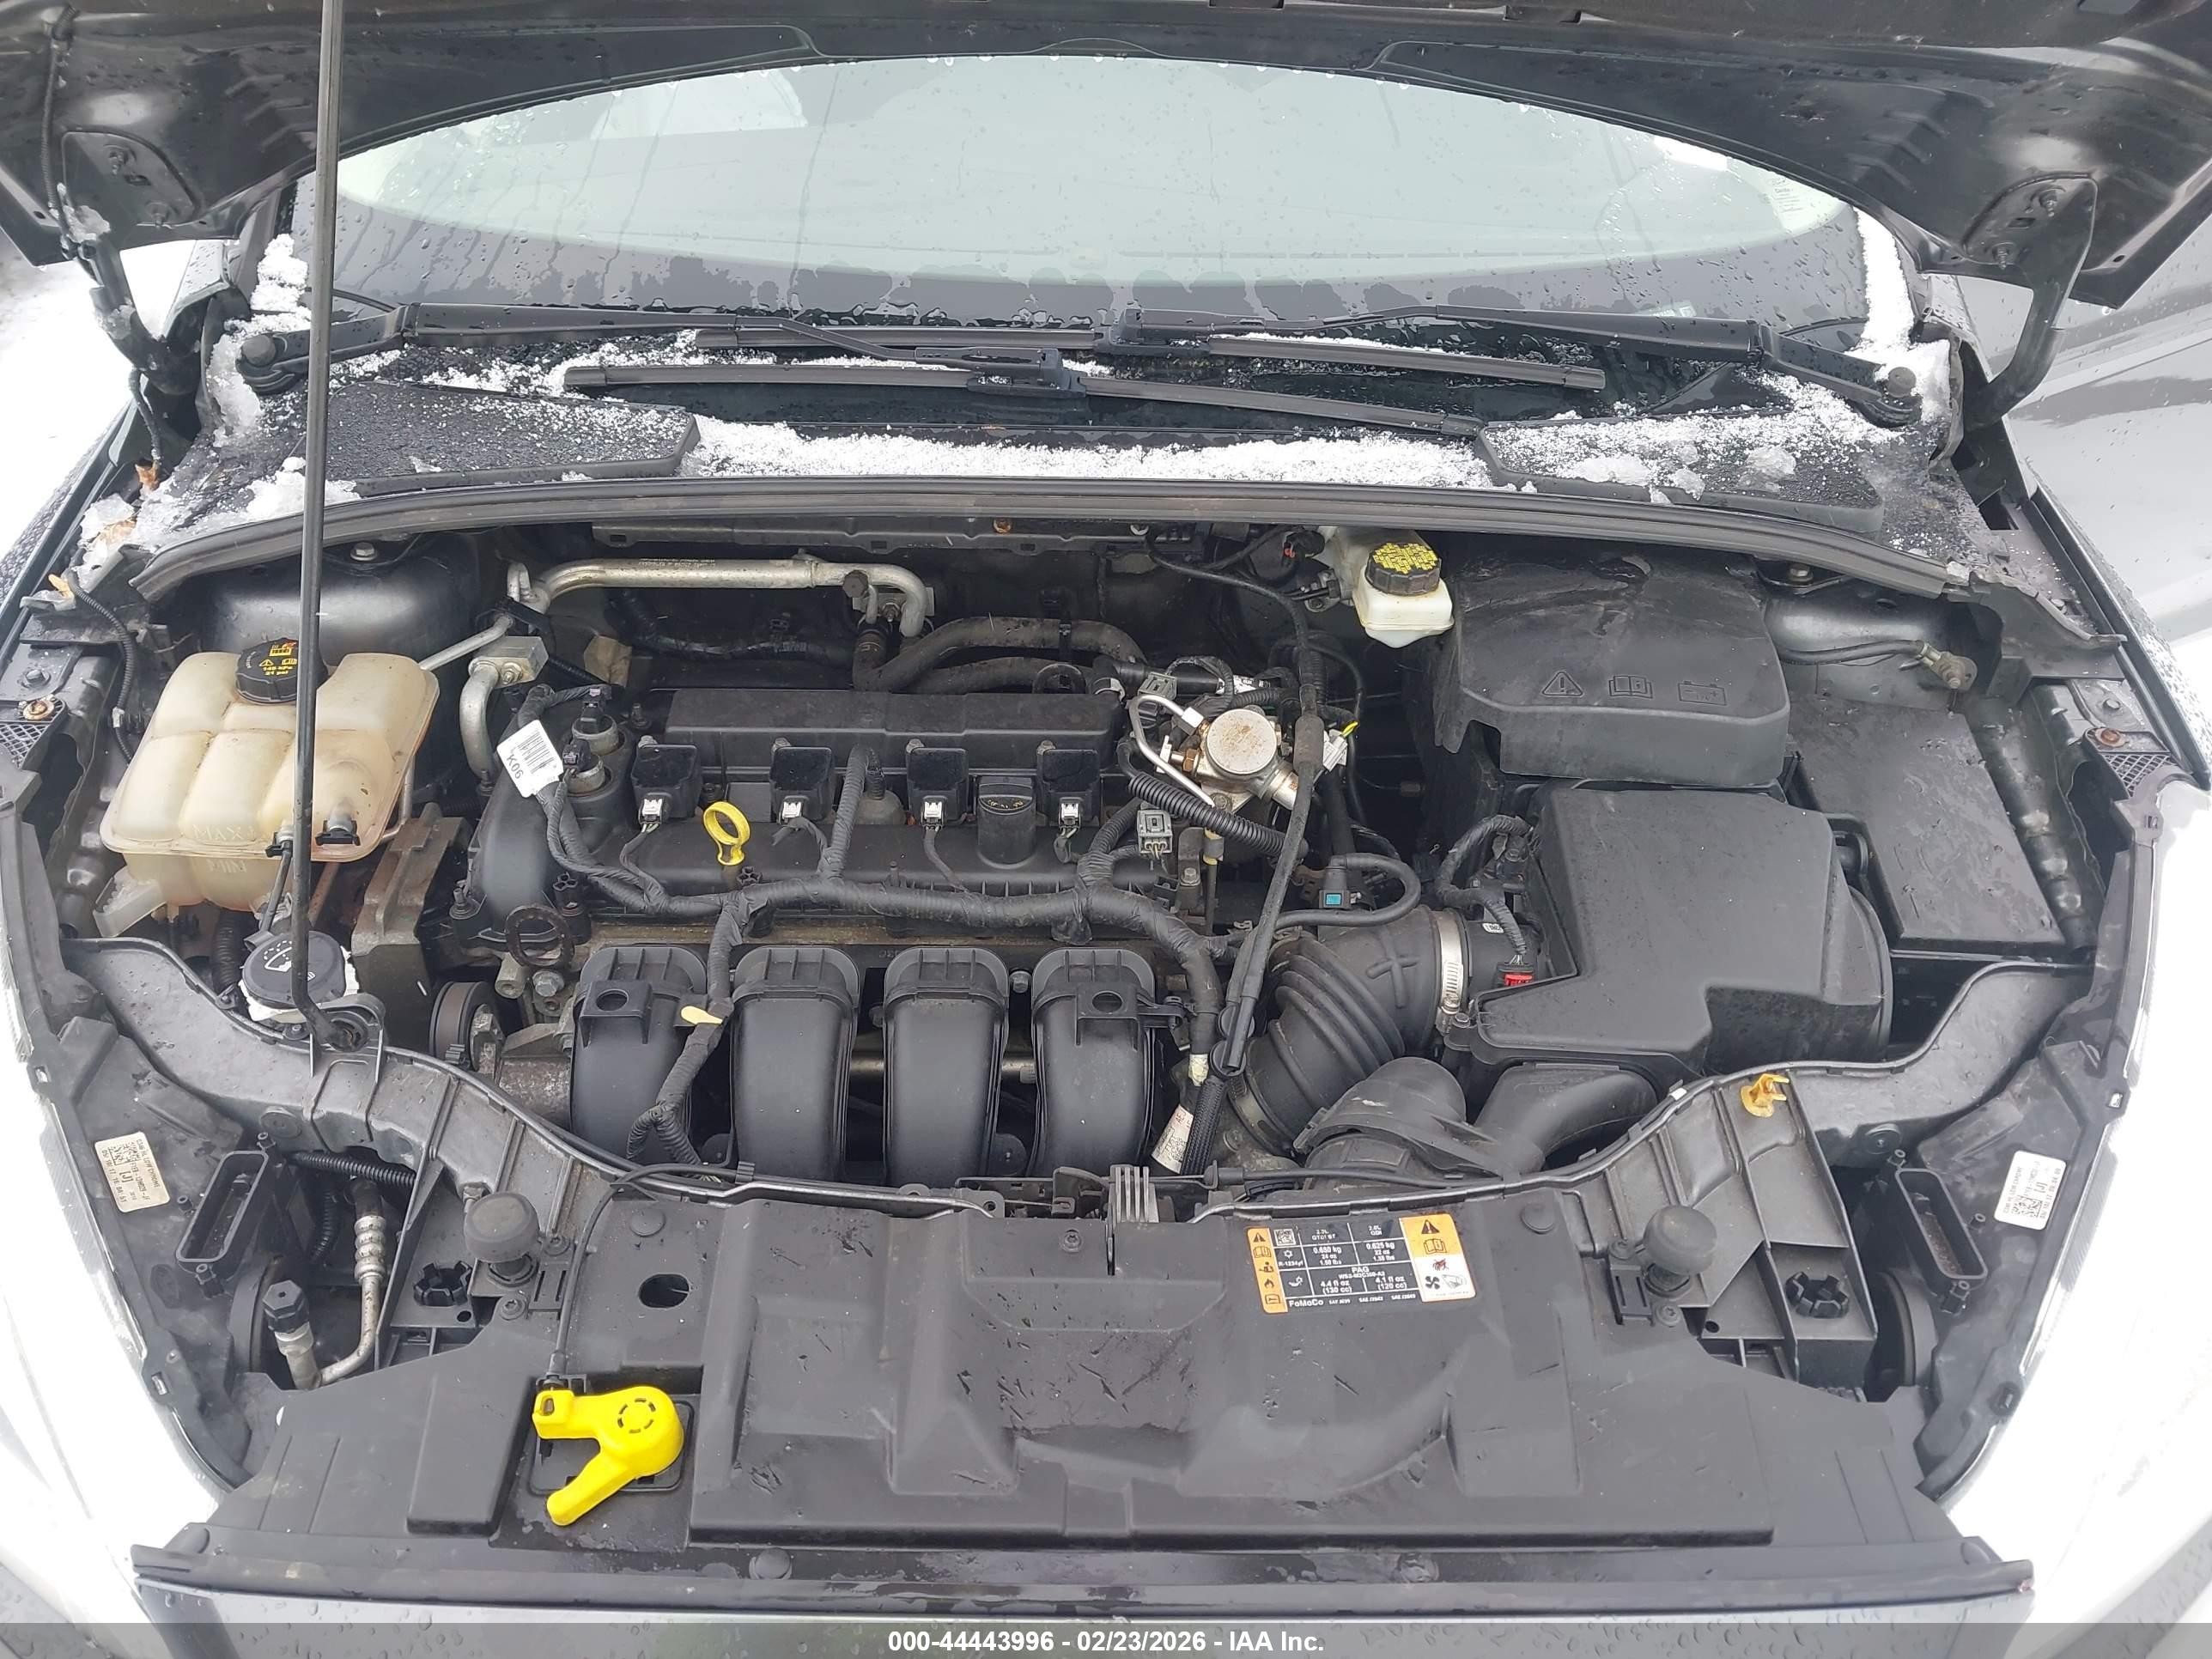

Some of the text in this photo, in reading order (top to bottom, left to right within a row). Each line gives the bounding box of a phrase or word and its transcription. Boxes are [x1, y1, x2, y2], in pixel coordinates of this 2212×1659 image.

[191, 823, 245, 841] MAX
[1322, 1286, 1339, 1295] (130
[1289, 1298, 1324, 1307] FoMoCo
